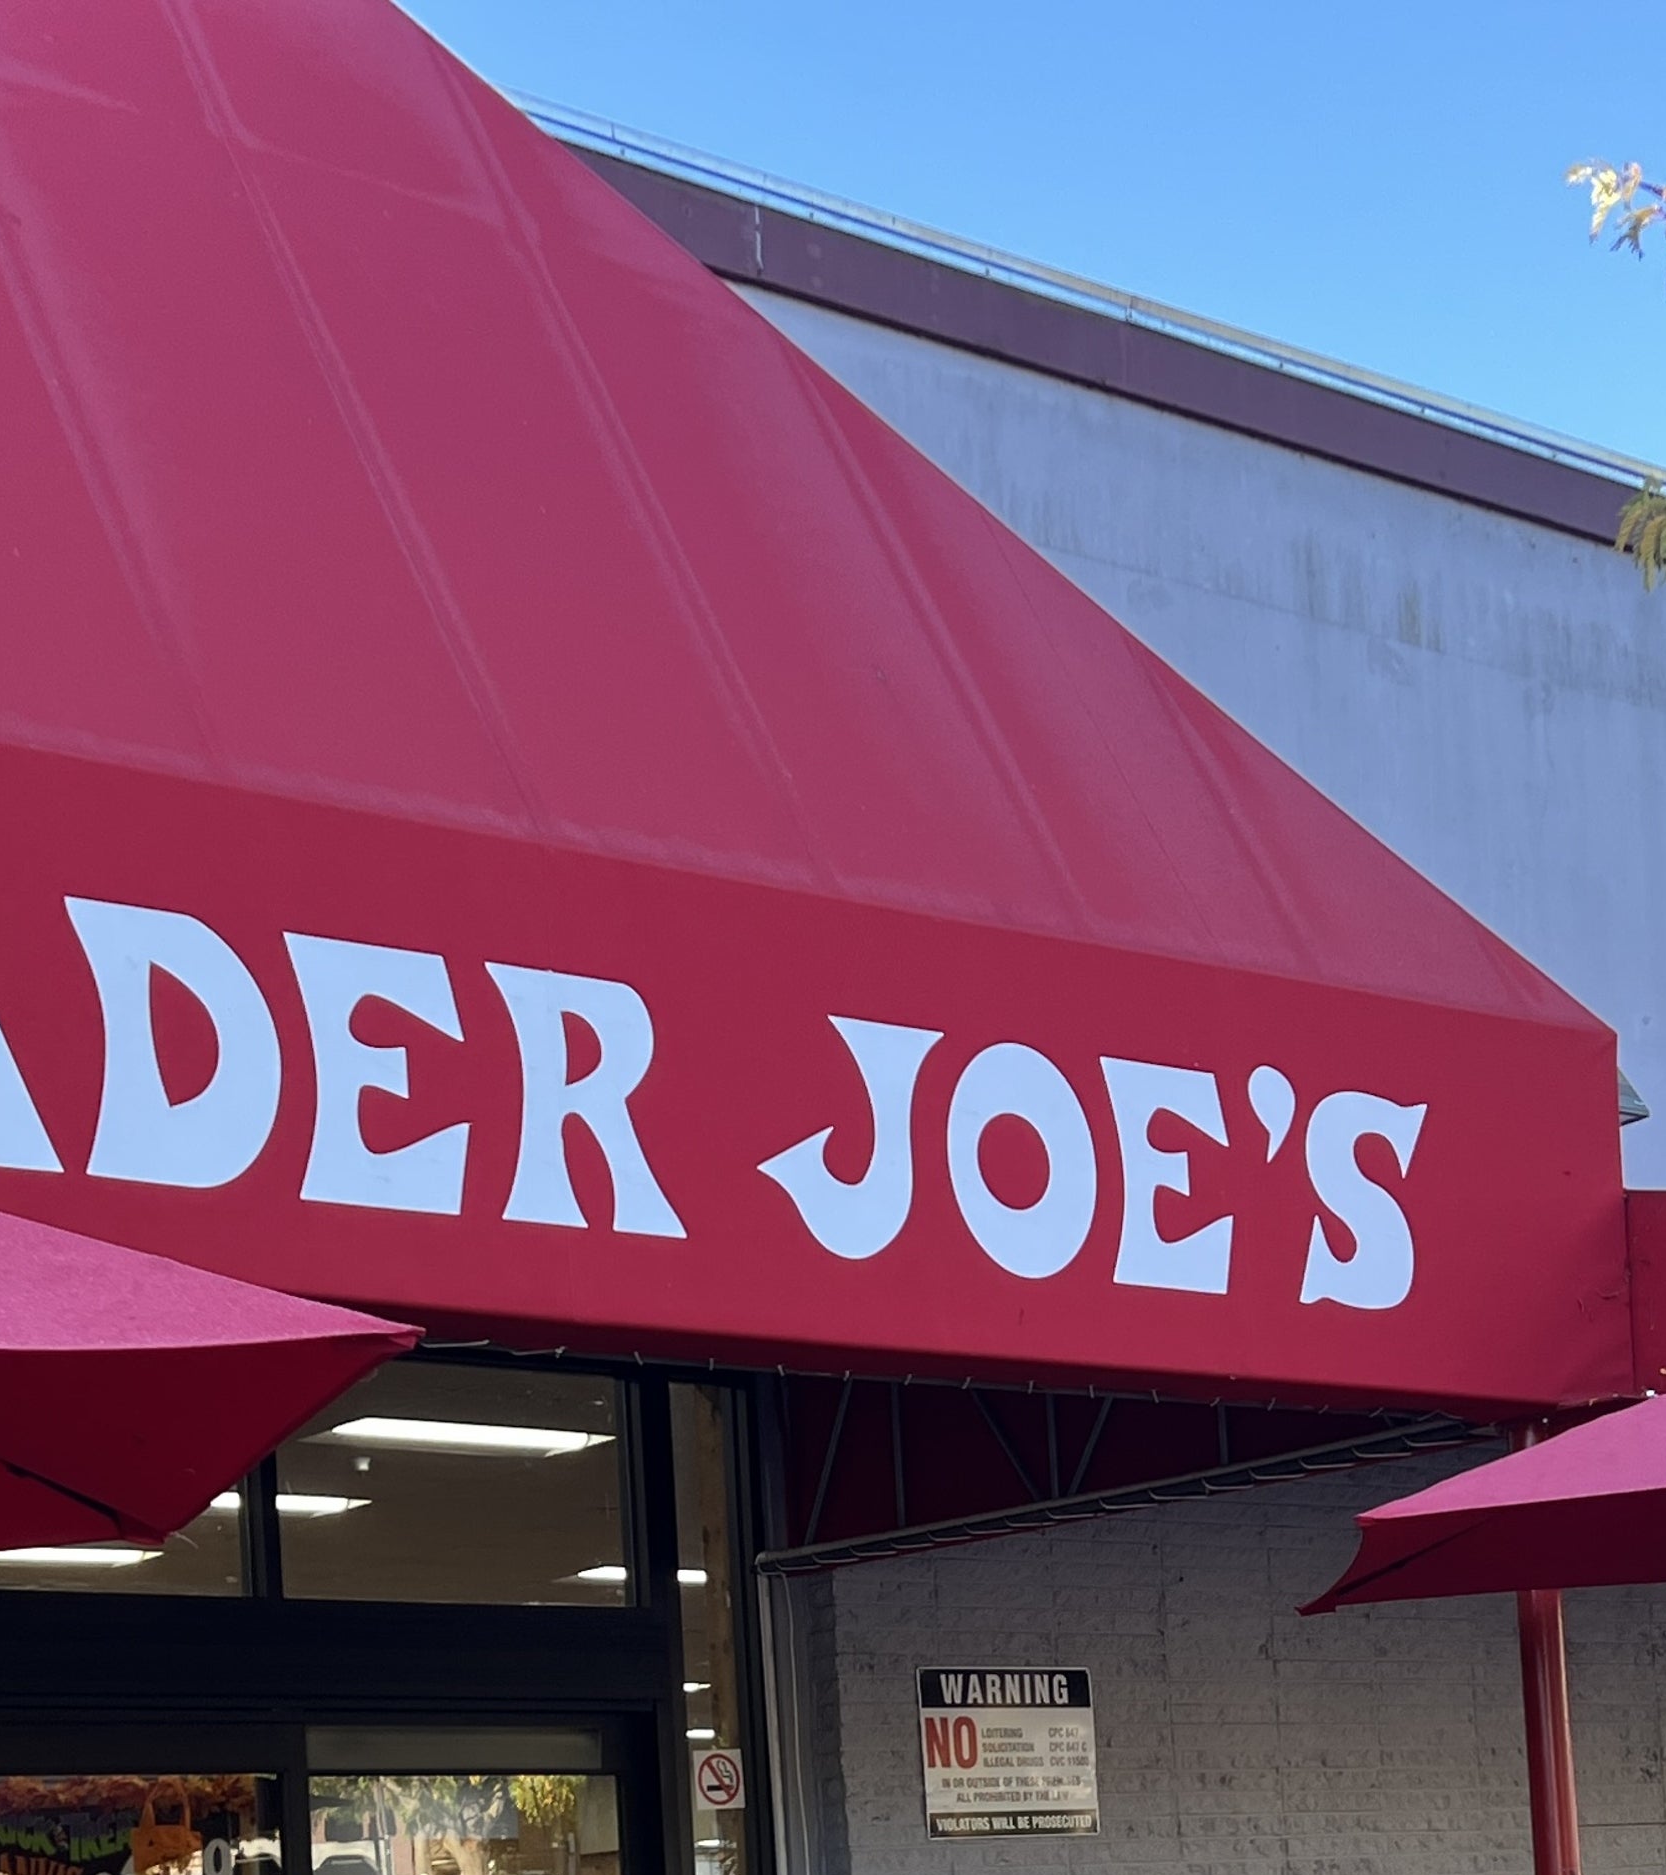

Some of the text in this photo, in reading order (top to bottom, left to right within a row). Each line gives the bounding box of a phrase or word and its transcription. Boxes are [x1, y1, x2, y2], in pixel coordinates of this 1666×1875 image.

[758, 1013, 1427, 1311] JOE'S
[939, 1673, 1069, 1705] WARNING
[924, 1715, 979, 1770] NO
[935, 1813, 1093, 1832] VIOLATORS WILL BE PROSECUTED
